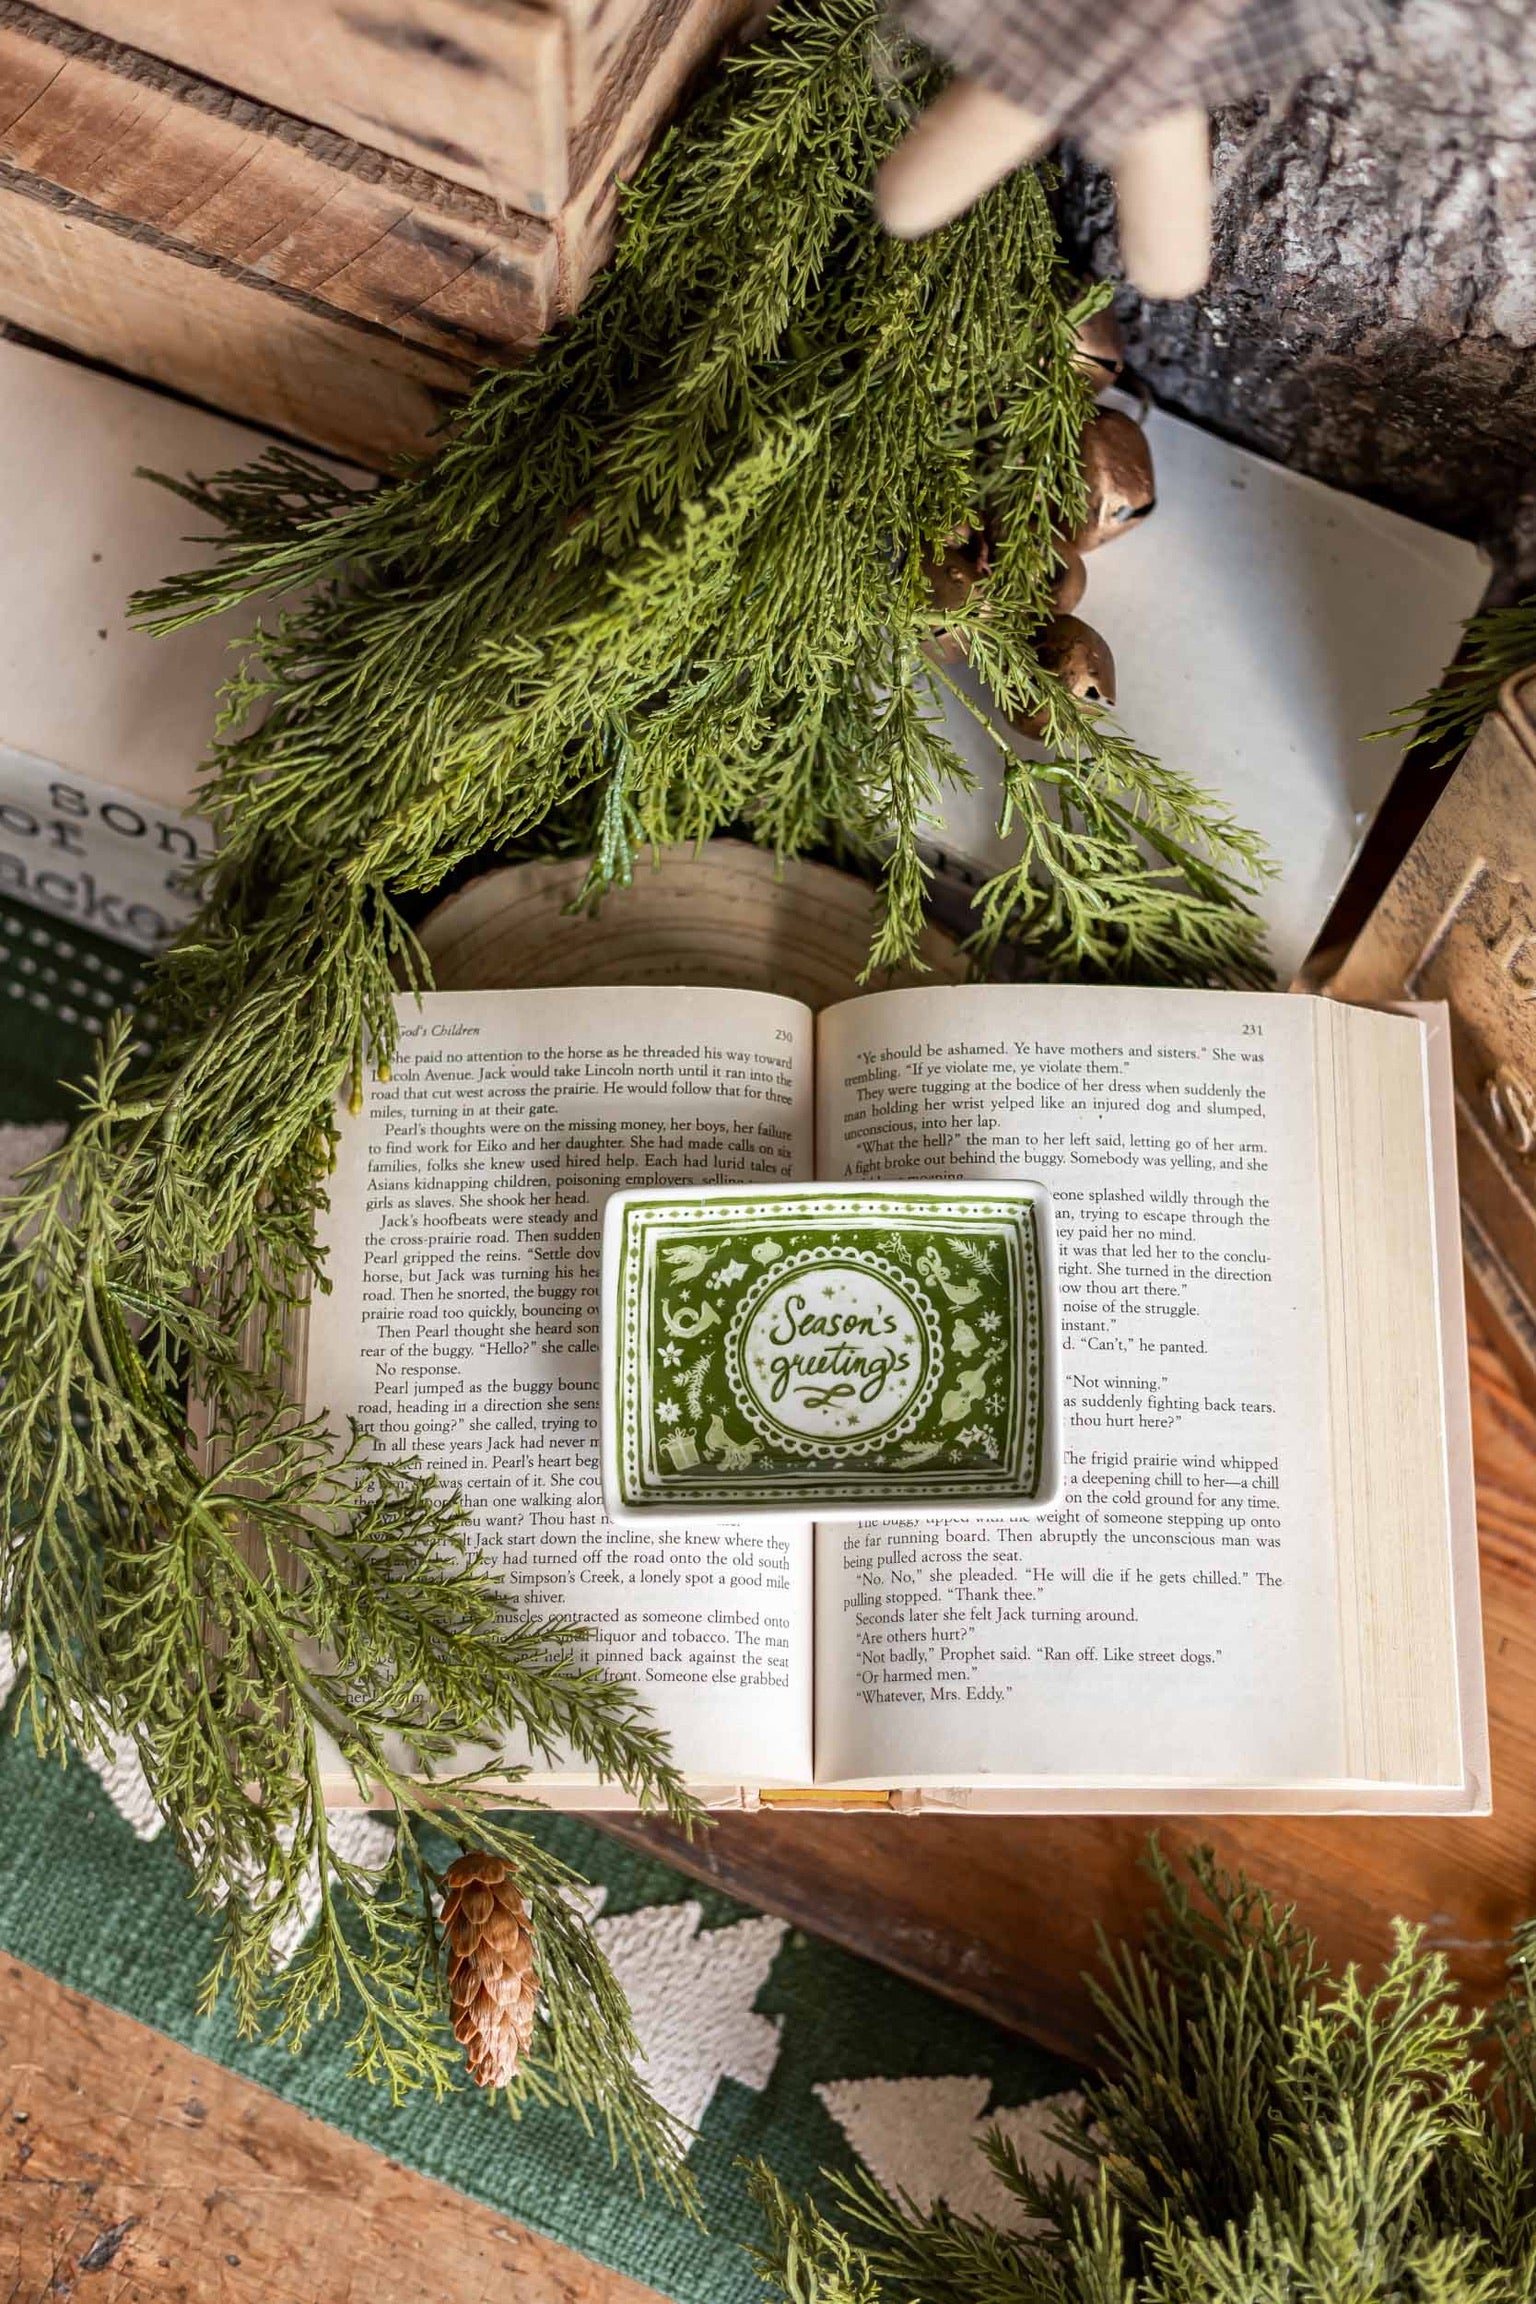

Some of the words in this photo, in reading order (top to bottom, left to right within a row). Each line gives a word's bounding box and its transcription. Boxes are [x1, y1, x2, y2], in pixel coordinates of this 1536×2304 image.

[431, 1023, 480, 1037] Children
[775, 1029, 793, 1043] 230
[1242, 1024, 1263, 1036] 231
[879, 1045, 923, 1063] should
[926, 1044, 943, 1057] be
[947, 1042, 1009, 1056] ashamed.
[1013, 1041, 1031, 1055] Ye
[1035, 1041, 1066, 1055] have
[1069, 1042, 1124, 1057] mothers
[1128, 1044, 1153, 1057] and
[1212, 1047, 1237, 1062] She
[1240, 1053, 1265, 1063] was
[371, 1087, 400, 1101] road
[403, 1087, 428, 1100] that
[431, 1089, 452, 1099] cut
[455, 1088, 484, 1099] west
[487, 1087, 527, 1098] across
[530, 1083, 551, 1097] the
[553, 1081, 599, 1099] prairie.
[603, 1080, 625, 1095] He
[626, 1080, 668, 1095] would
[671, 1081, 713, 1095] follow
[715, 1082, 741, 1097] that
[743, 1084, 763, 1100] for
[765, 1088, 793, 1106] three
[369, 1105, 407, 1120] miles,
[411, 1105, 458, 1121] turning
[461, 1104, 475, 1117] in
[478, 1106, 491, 1117] at
[495, 1102, 526, 1116] their
[528, 1103, 559, 1119] gate.
[385, 1123, 427, 1137] Pearl's
[430, 1121, 487, 1139] thoughts
[489, 1124, 521, 1134] were
[523, 1123, 541, 1133] on
[543, 1119, 566, 1133] the
[567, 1119, 618, 1138] missing
[619, 1121, 667, 1138] money,
[669, 1117, 693, 1131] her
[693, 1118, 730, 1135] boys,
[732, 1119, 755, 1135] her
[757, 1123, 793, 1141] failure
[843, 1120, 917, 1141] unconscious,
[921, 1117, 948, 1129] into
[950, 1115, 974, 1129] her
[977, 1114, 1001, 1131] lap.
[898, 1135, 919, 1150] the
[965, 1132, 988, 1147] the
[991, 1136, 1021, 1147] man
[1025, 1135, 1039, 1146] to
[1043, 1132, 1065, 1146] her
[1069, 1132, 1091, 1146] left
[1095, 1133, 1125, 1149] said,
[1129, 1134, 1171, 1152] letting
[1175, 1140, 1192, 1152] go
[1195, 1137, 1210, 1151] of
[1213, 1136, 1236, 1151] her
[1239, 1143, 1267, 1153] arm.
[365, 1196, 394, 1213] girls
[397, 1199, 411, 1209] as
[414, 1195, 455, 1209] slaves.
[459, 1194, 484, 1208] She
[486, 1193, 527, 1207] shook
[529, 1192, 552, 1206] her
[553, 1191, 590, 1206] head.
[1088, 1188, 1145, 1205] splashed
[1149, 1190, 1189, 1207] wildly
[1193, 1192, 1245, 1210] through
[1249, 1194, 1270, 1209] the
[378, 1214, 419, 1231] Jack's
[423, 1213, 488, 1227] hoofbeats
[491, 1215, 524, 1225] were
[527, 1210, 571, 1227] steady
[573, 1210, 601, 1223] and
[1063, 1299, 1098, 1313] noise
[1101, 1300, 1116, 1313] of
[1119, 1300, 1141, 1314] the
[1144, 1303, 1200, 1319] struggle.
[769, 1294, 898, 1346] Season's
[376, 1325, 411, 1339] Then
[415, 1324, 449, 1338] Pearl
[453, 1323, 505, 1341] thought
[509, 1322, 531, 1337] she
[535, 1321, 573, 1336] heard
[1139, 1339, 1156, 1352] he
[1159, 1341, 1208, 1356] panted.
[375, 1362, 397, 1376] No
[400, 1365, 461, 1379] response.
[770, 1341, 911, 1404] greetings
[1070, 1412, 1102, 1427] thou
[1105, 1412, 1135, 1428] hurt
[509, 1570, 576, 1588] Simpson's
[579, 1570, 624, 1585] Creek,
[628, 1573, 636, 1584] a
[639, 1570, 681, 1587] lonely
[685, 1573, 713, 1587] spot
[718, 1575, 726, 1585] a
[729, 1574, 762, 1589] good
[766, 1575, 790, 1590] mile
[523, 1589, 566, 1605] shiver.
[843, 1594, 883, 1613] pulling
[885, 1589, 942, 1607] stopped.
[855, 1610, 905, 1627] Seconds
[909, 1609, 939, 1623] later
[942, 1607, 967, 1621] she
[969, 1607, 993, 1621] felt
[994, 1608, 1027, 1624] Jack
[1031, 1607, 1082, 1625] turning
[1085, 1609, 1139, 1622] around.
[594, 1629, 637, 1647] liquor
[641, 1629, 667, 1643] and
[672, 1630, 730, 1644] tobacco.
[737, 1631, 761, 1645] The
[765, 1637, 789, 1649] man
[886, 1628, 927, 1644] others
[940, 1646, 996, 1663] Prophet
[999, 1647, 1031, 1661] said.
[1075, 1648, 1099, 1661] off.
[1103, 1649, 1135, 1662] Like
[1138, 1651, 1175, 1663] street
[645, 1668, 708, 1683] Someone
[711, 1670, 737, 1684] else
[739, 1672, 789, 1688] grabbed
[882, 1667, 933, 1683] harmed
[930, 1688, 961, 1701] Mrs.
